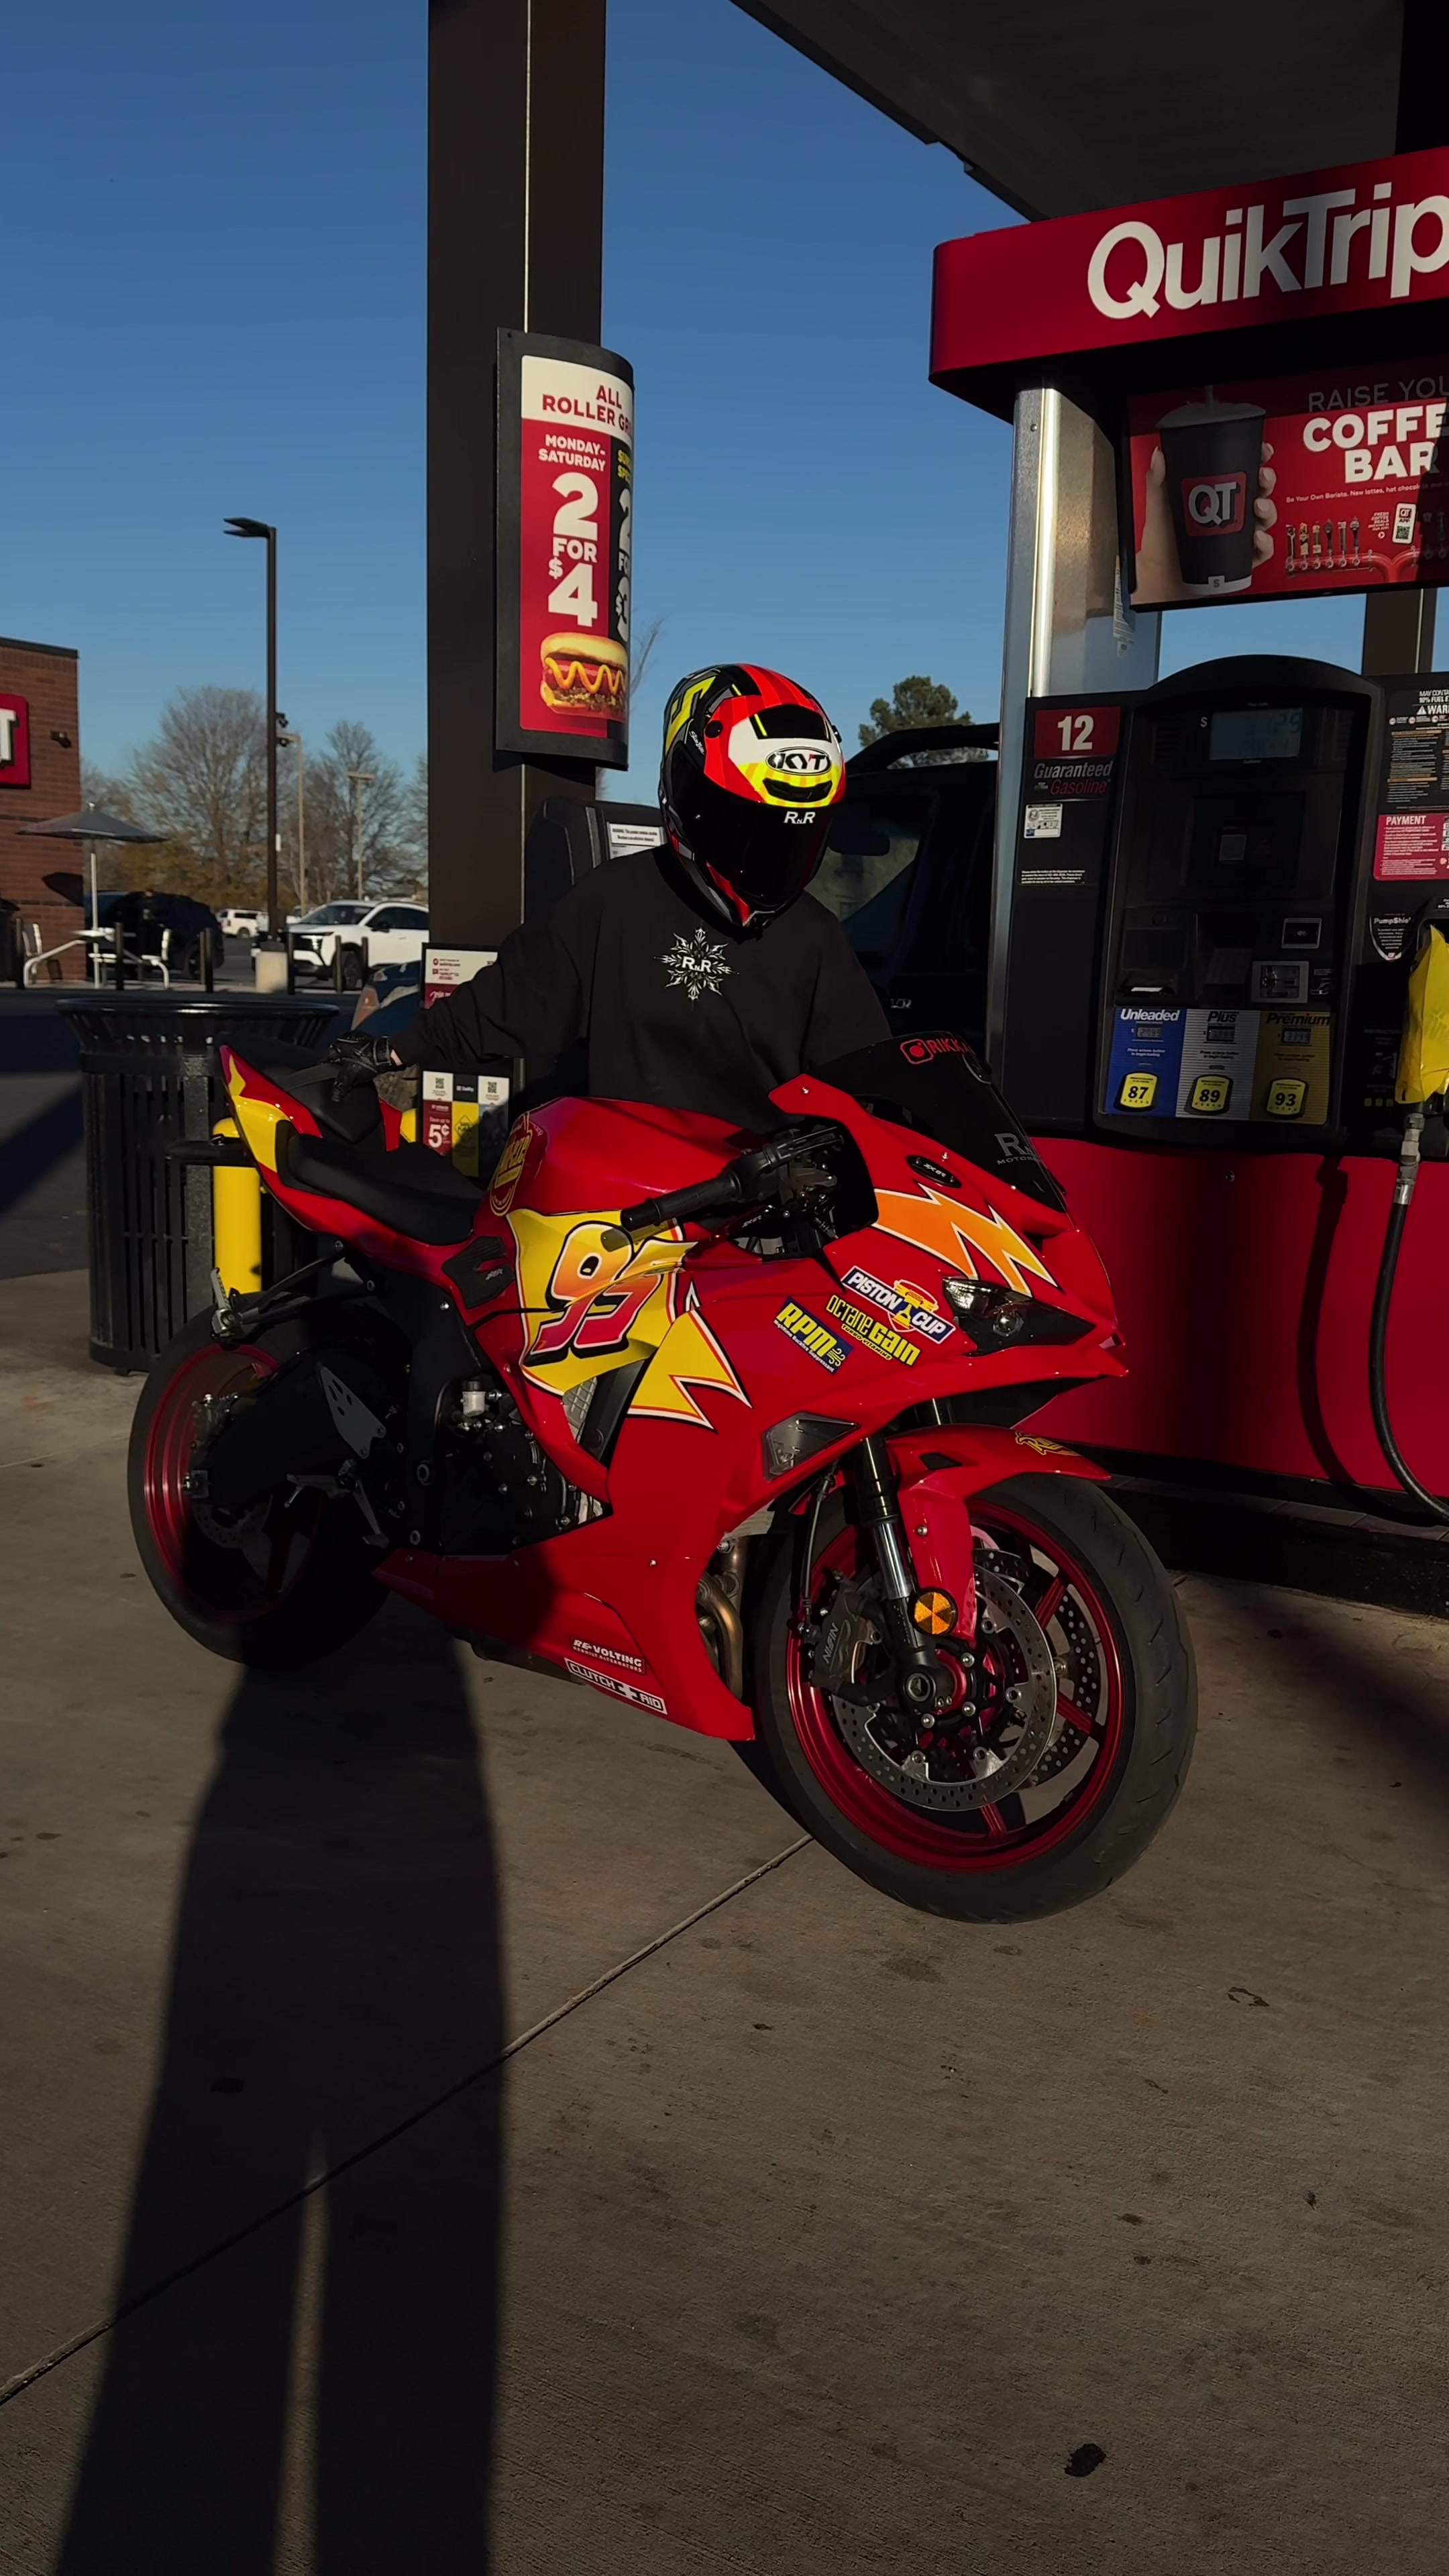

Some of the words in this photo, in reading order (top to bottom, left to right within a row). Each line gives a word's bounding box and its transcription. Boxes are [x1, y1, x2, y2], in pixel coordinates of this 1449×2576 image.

[1087, 182, 1449, 319] QuikTrip
[596, 384, 622, 410] ALL
[1309, 382, 1389, 413] RAISE
[542, 394, 615, 427] ROLLER
[545, 435, 606, 456] MONDAY-
[539, 448, 606, 472] SATURDAY
[1345, 441, 1440, 483] BAR
[552, 472, 598, 540] 2
[1189, 482, 1236, 525] QT
[553, 538, 597, 562] FOR
[1214, 579, 1220, 588] S
[1058, 715, 1094, 751] 12
[1200, 716, 1208, 728] $
[767, 751, 829, 771] KYT
[1034, 760, 1114, 780] Guaranteed
[1050, 778, 1107, 796] Gasoline
[1386, 815, 1426, 826] PAYMENT
[1374, 916, 1411, 926] PumpShie
[1120, 1008, 1181, 1021] Unleaded
[1208, 1011, 1236, 1023] Plus
[1266, 1012, 1330, 1026] Premium
[1128, 1085, 1148, 1099] 87
[1199, 1089, 1220, 1103] 89
[1275, 1092, 1297, 1107] 93
[847, 1271, 902, 1310] PISTON
[776, 1303, 837, 1357] RPM
[911, 1311, 947, 1334] CUP
[841, 1324, 863, 1342] TURBO
[861, 1338, 893, 1360] VITAMINS
[574, 1639, 642, 1667] RE-VOLTING
[570, 1662, 616, 1690] CLUTCH
